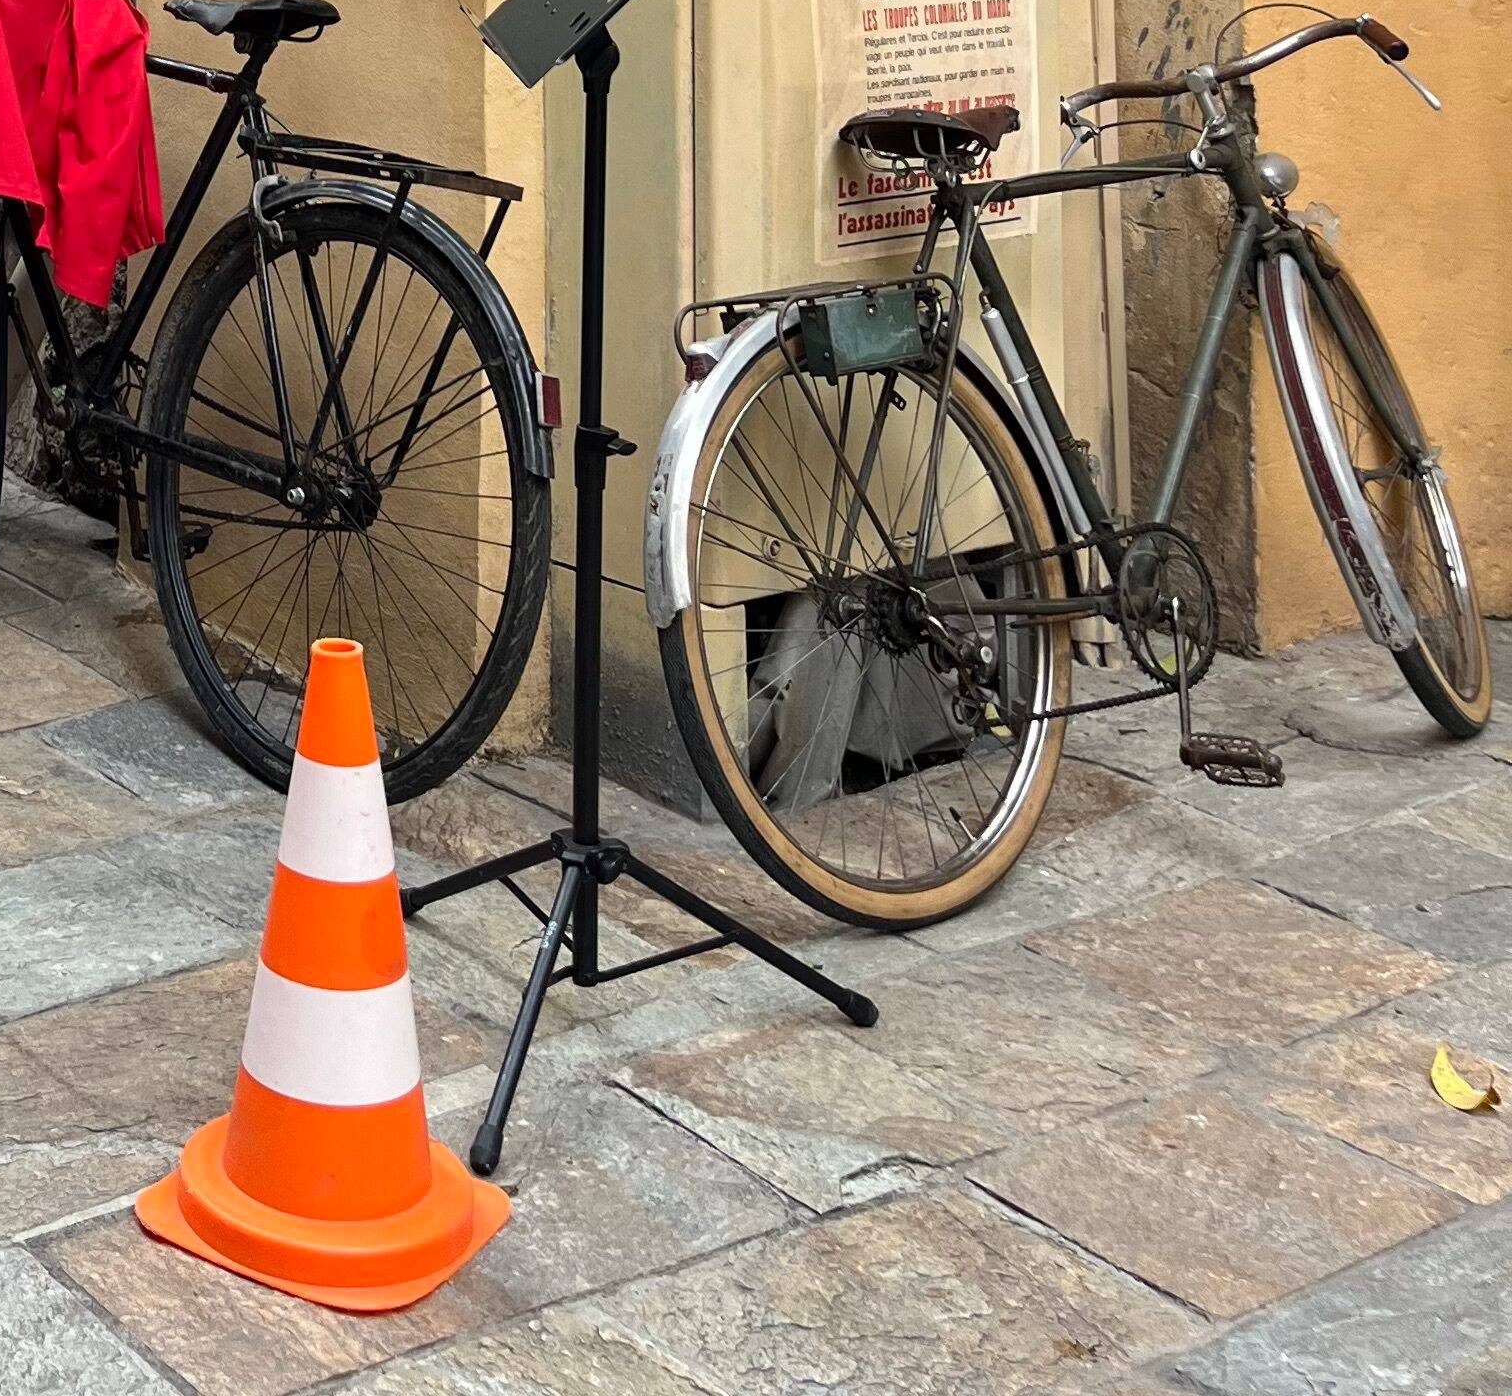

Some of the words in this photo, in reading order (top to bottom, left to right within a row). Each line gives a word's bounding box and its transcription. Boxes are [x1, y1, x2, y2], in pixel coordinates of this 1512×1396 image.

[862, 9, 878, 32] LES
[884, 6, 920, 30] TROUPES
[924, 2, 968, 26] COLONIALES
[972, 0, 982, 21] DU
[838, 177, 859, 199] Le
